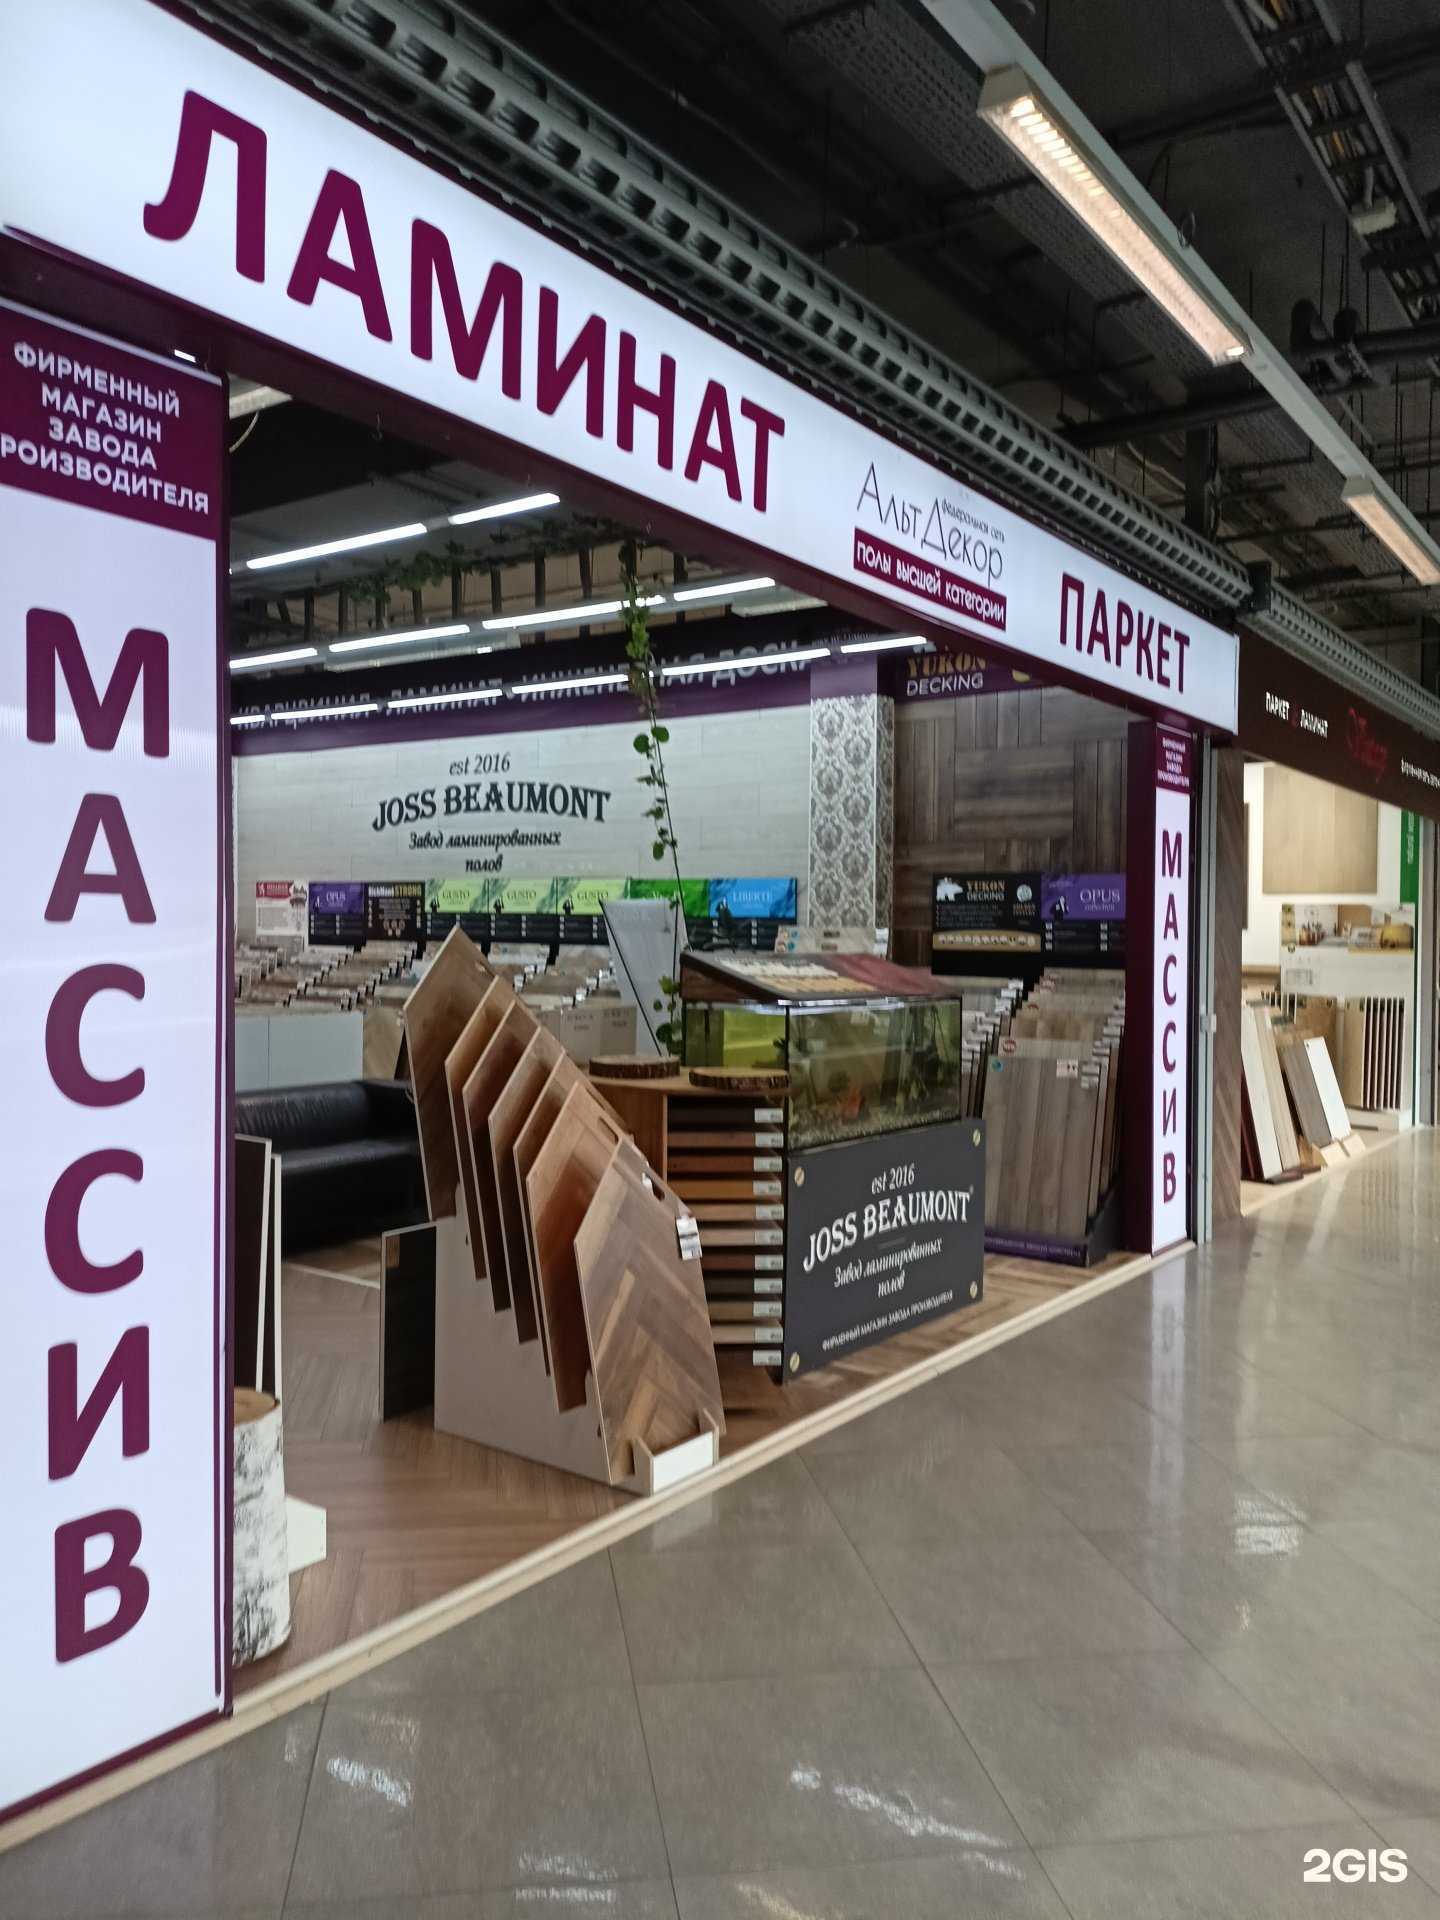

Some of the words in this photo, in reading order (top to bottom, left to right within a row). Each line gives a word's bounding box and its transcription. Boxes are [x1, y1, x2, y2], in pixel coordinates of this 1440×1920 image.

[143, 90, 786, 513] ЛАМИНАТ
[14, 341, 180, 418] ФИРМЕННЫЙ
[41, 382, 162, 443] МАГАЗИН
[48, 416, 157, 470] ЗАВОДА
[1060, 571, 1190, 693] ПАРКЕТ
[906, 672, 984, 697] DECKING
[1265, 691, 1290, 721] ПАРКЕТ
[449, 757, 469, 776] est
[473, 752, 511, 775] 2016
[372, 788, 437, 831] JOSS
[444, 781, 611, 823] BEAUMONT
[408, 831, 443, 850] Завод
[445, 828, 562, 852] ламинированных
[465, 853, 504, 873] полов
[1080, 888, 1120, 904] OPUS
[1161, 829, 1183, 1204] МАССИВ
[26, 608, 170, 1664] МАССИВ
[871, 1171, 887, 1195] est
[889, 1163, 915, 1189] 2016
[803, 1211, 857, 1273] JOSS
[863, 1190, 970, 1240] BEAUMONT
[834, 1258, 863, 1288] Завод
[863, 1238, 943, 1277] ламинированных
[877, 1270, 906, 1298] полов
